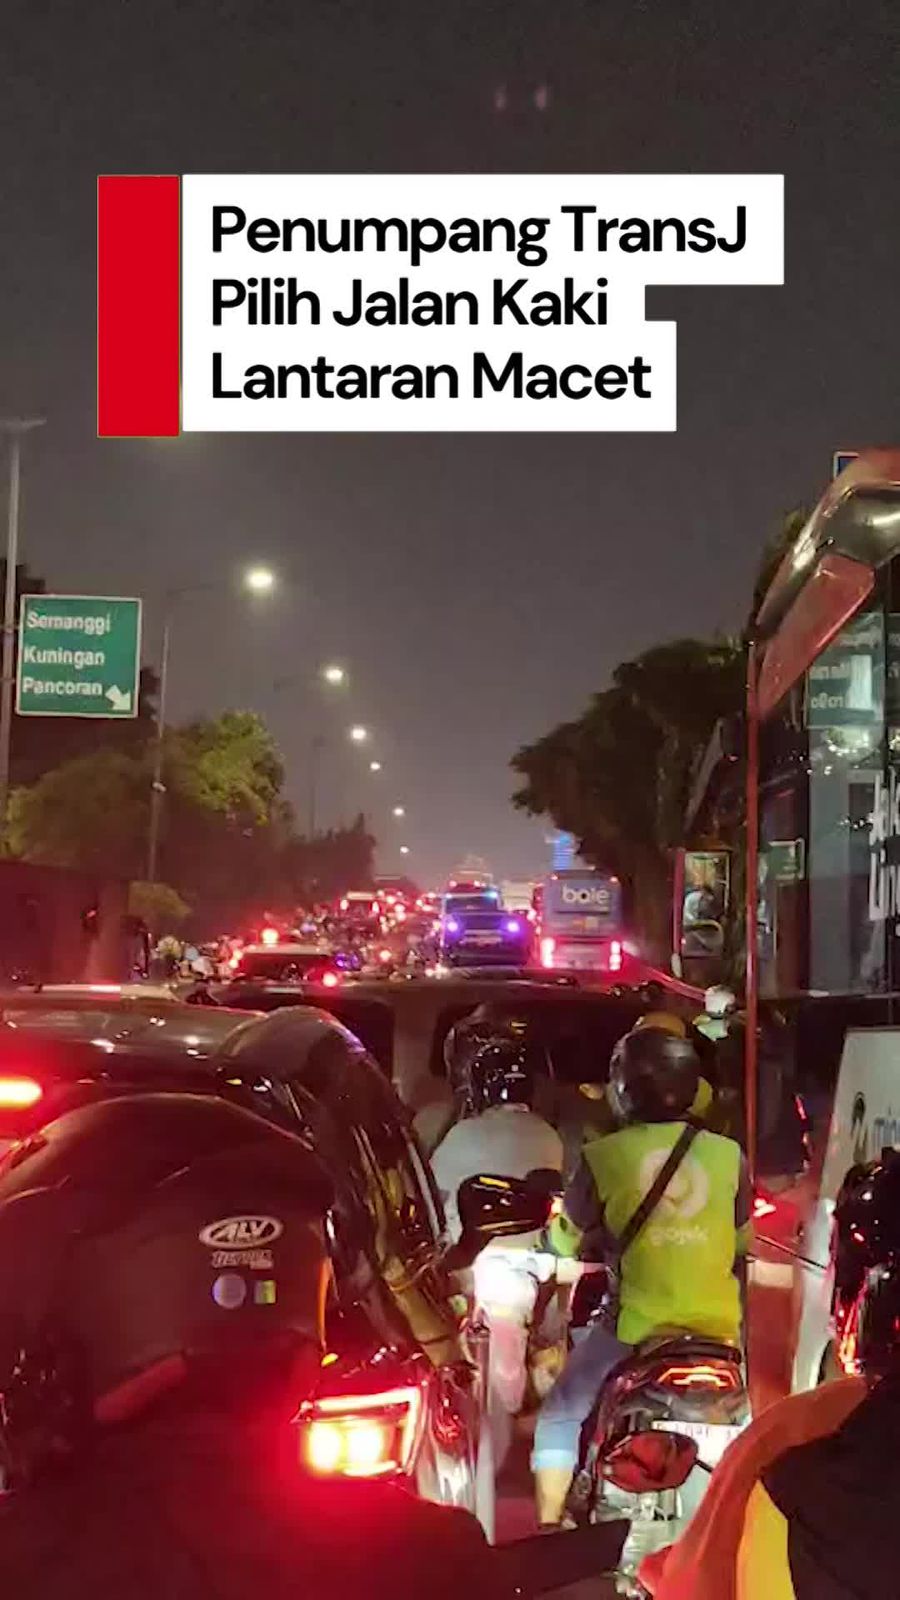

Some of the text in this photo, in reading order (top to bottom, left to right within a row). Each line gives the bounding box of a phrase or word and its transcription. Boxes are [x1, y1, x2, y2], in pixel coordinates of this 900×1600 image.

[27, 611, 111, 635] Semanggi
[23, 645, 105, 669] Kuningan
[22, 677, 103, 695] Pancoran
